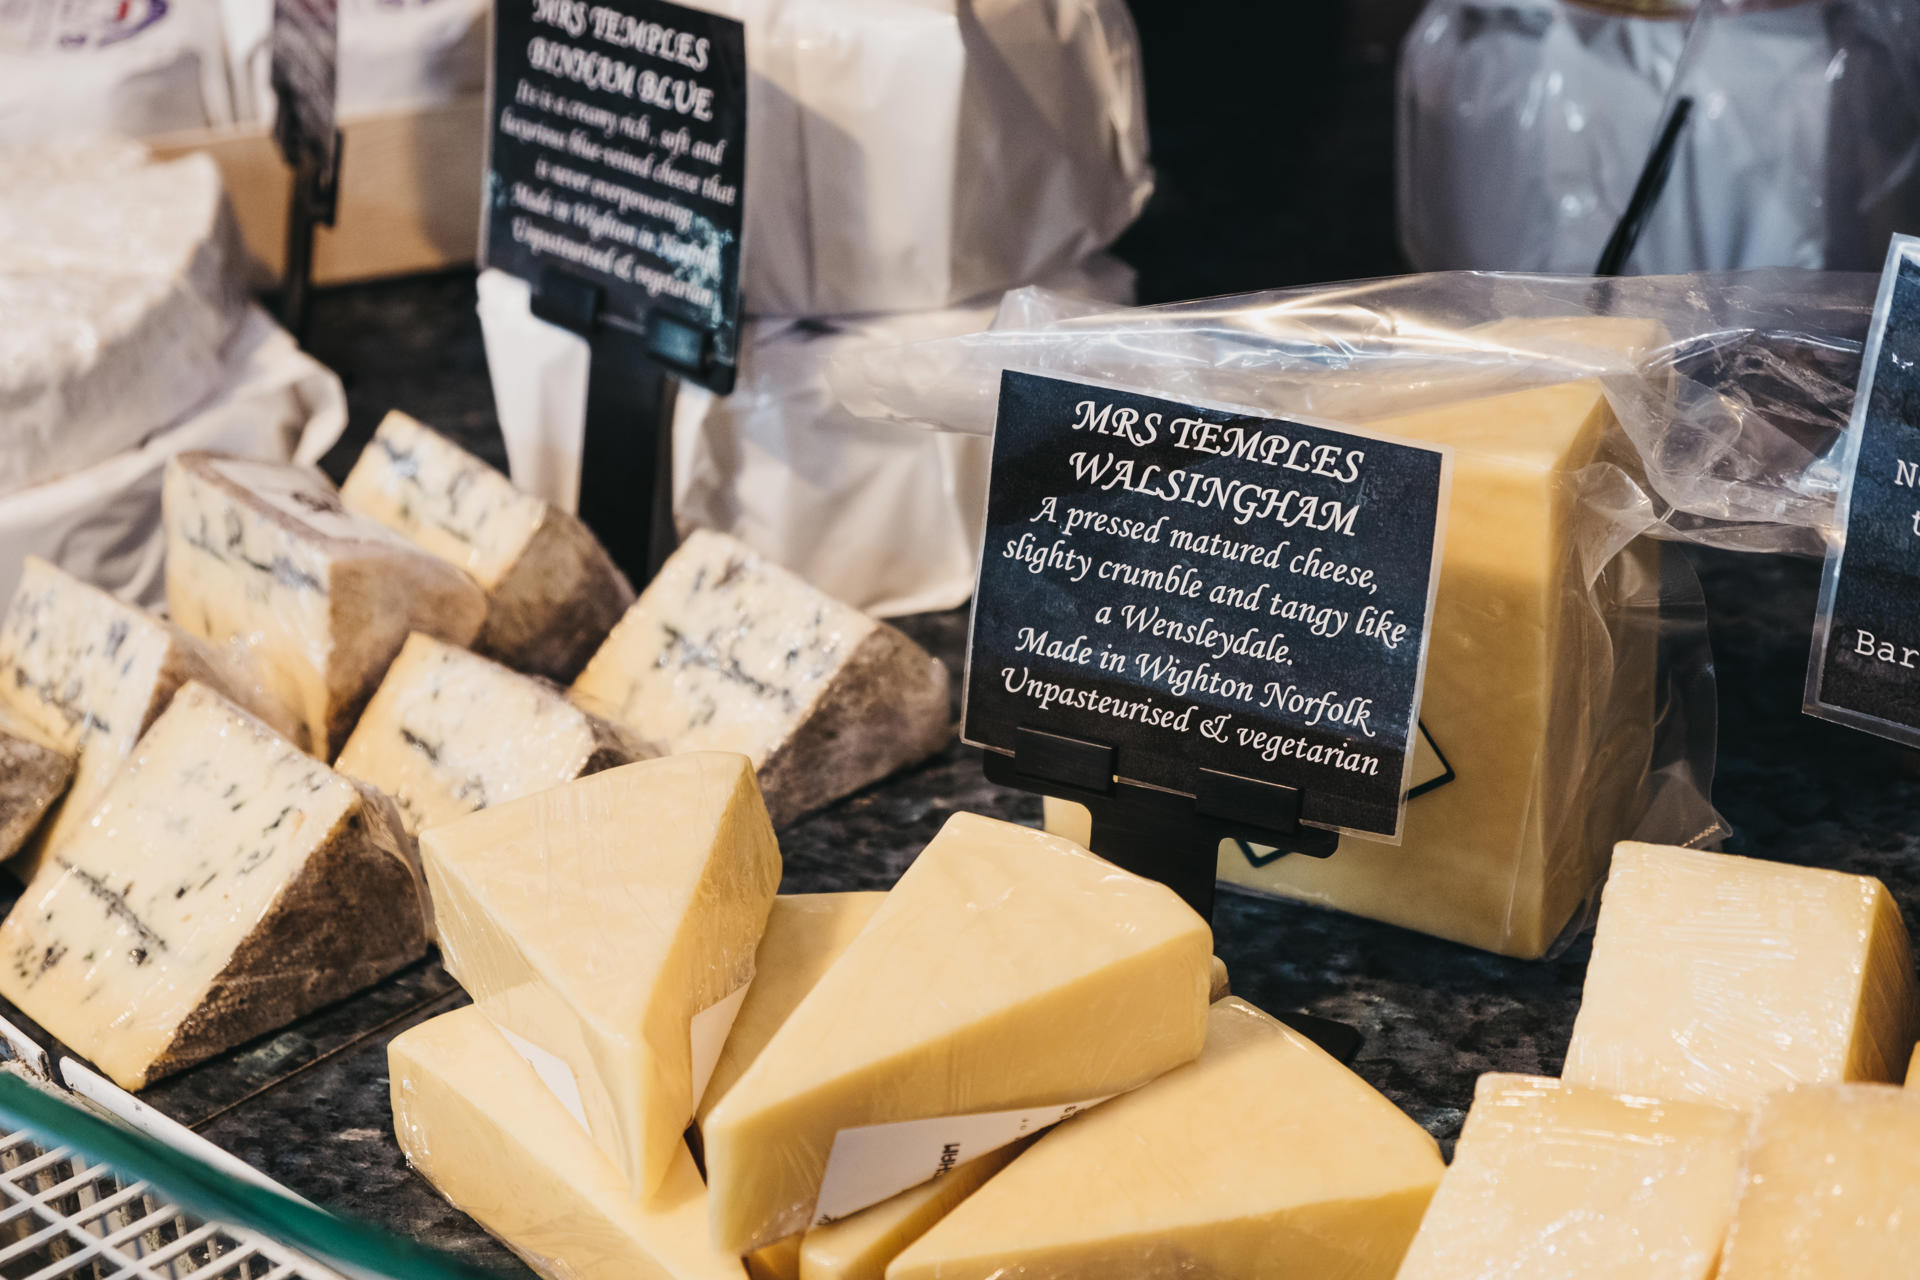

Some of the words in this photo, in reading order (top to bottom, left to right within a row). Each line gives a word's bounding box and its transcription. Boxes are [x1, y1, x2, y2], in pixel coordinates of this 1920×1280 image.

[532, 0, 588, 36] MRS
[590, 8, 710, 71] TEMPLES
[528, 37, 634, 98] BINHAM
[637, 70, 713, 121] BLUE
[566, 101, 618, 138] creamy
[660, 127, 690, 158] soft
[691, 140, 726, 165] and
[513, 181, 552, 215] Made
[552, 200, 570, 222] in
[572, 202, 636, 242] Wighton
[655, 157, 700, 194] cheese
[702, 174, 736, 205] that
[512, 216, 616, 273] Unpasteurised
[635, 262, 714, 306] vegetarian
[1072, 401, 1162, 446] MRS
[1170, 417, 1364, 482] TEMPLES
[1070, 452, 1360, 536] WALSINGHAM
[1030, 497, 1057, 522] A
[1061, 506, 1167, 543] pressed
[1169, 517, 1288, 568] matured
[1289, 545, 1377, 594] cheese,
[1003, 533, 1092, 582] slighty
[1099, 561, 1202, 597] crumble
[1209, 584, 1269, 611] and
[1270, 596, 1348, 638] tangy
[1356, 606, 1406, 649] like
[1096, 607, 1112, 624] a
[1121, 605, 1292, 665] Wensleydale.
[1002, 667, 1198, 732] Unpasteurised
[1200, 714, 1231, 743] &
[1237, 728, 1378, 775] vegetarian
[1015, 628, 1092, 664] Made
[1100, 644, 1125, 673] in
[1136, 654, 1253, 702] Wighton
[1260, 683, 1376, 736] Norfolk
